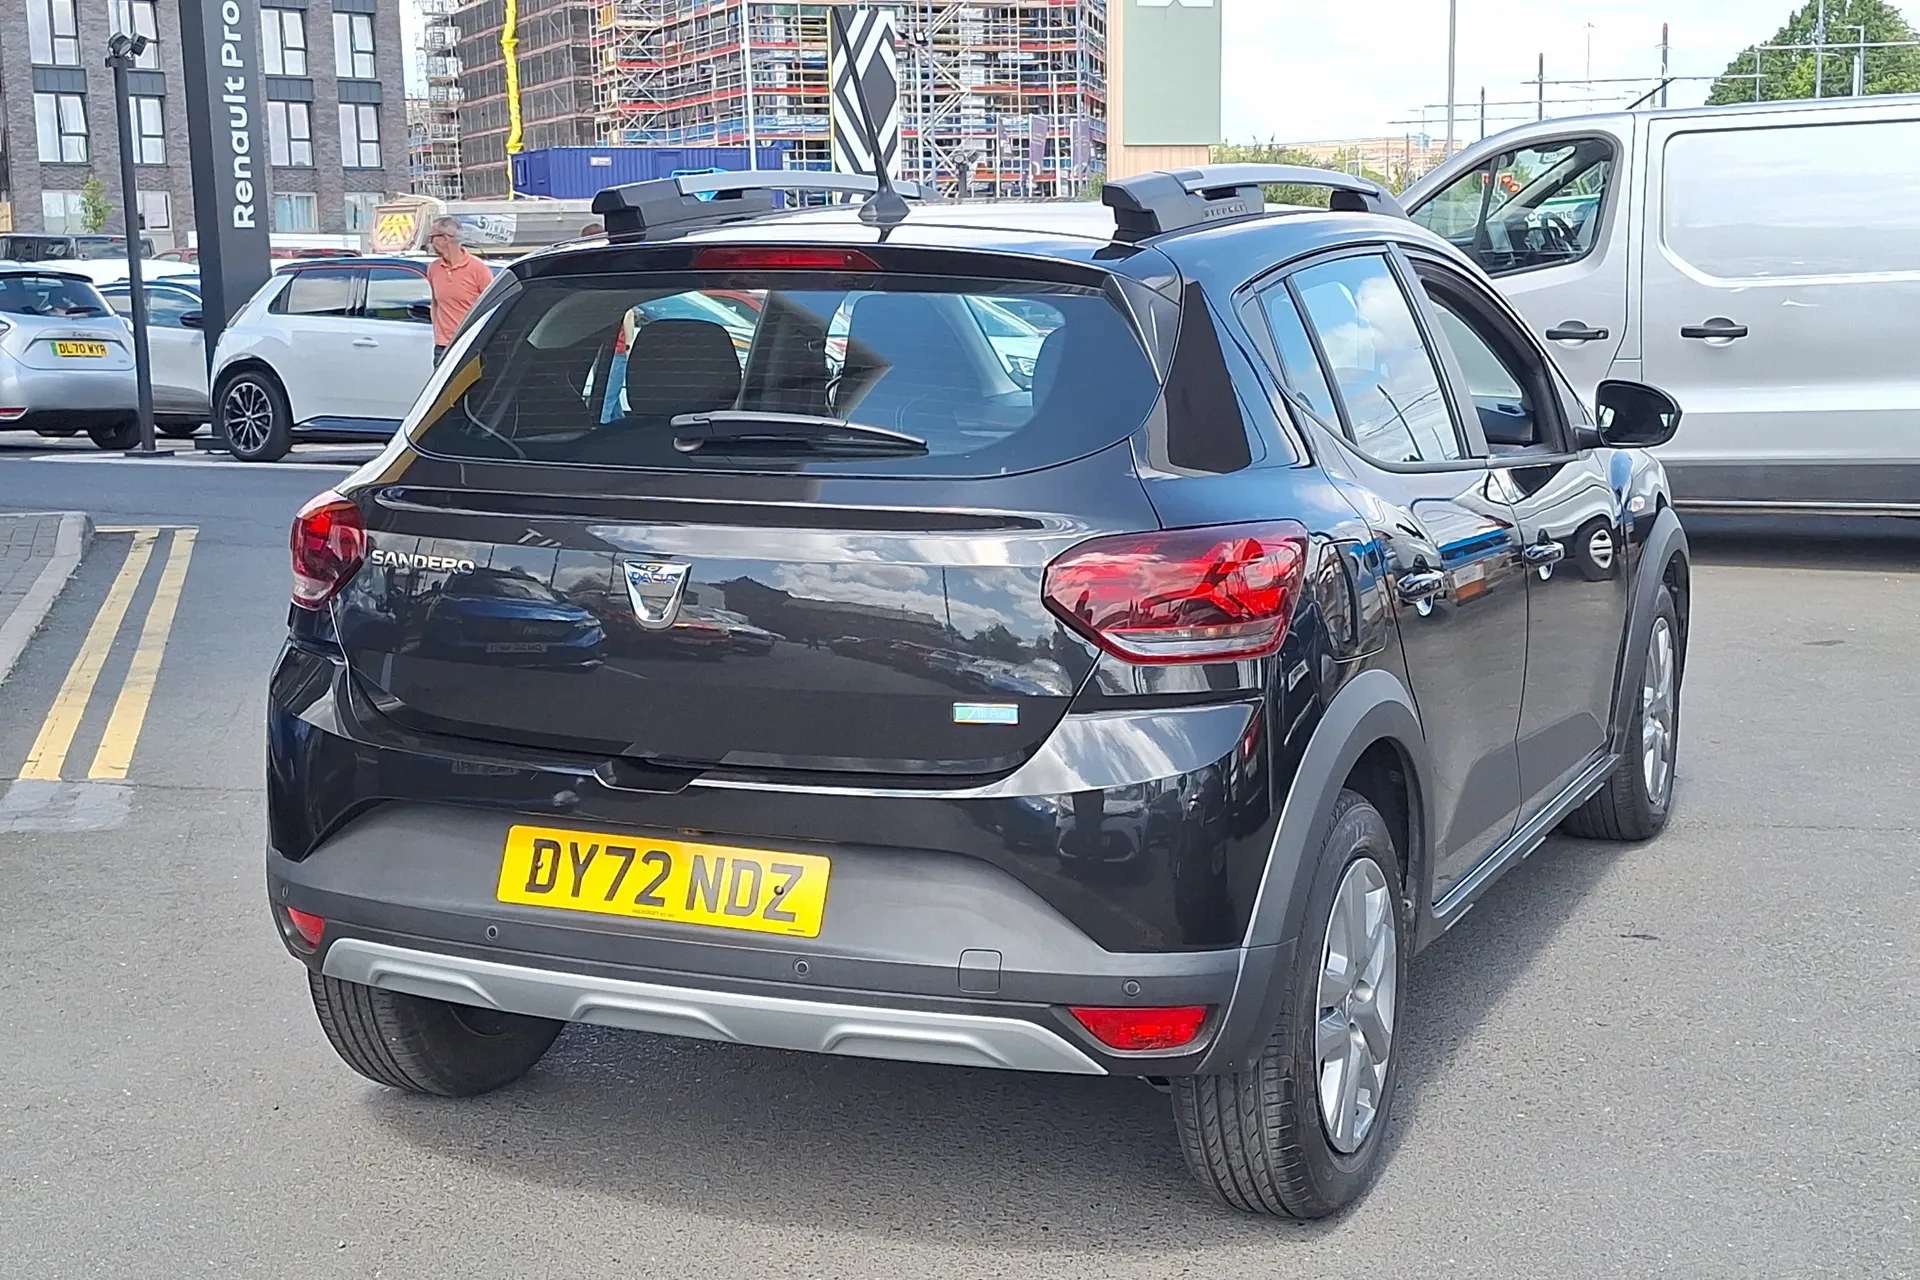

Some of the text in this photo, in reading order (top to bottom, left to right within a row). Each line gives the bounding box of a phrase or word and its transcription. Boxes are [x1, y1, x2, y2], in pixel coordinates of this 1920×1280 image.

[221, 0, 255, 228] Renault Pro
[371, 550, 475, 575] SANDERO
[630, 571, 678, 584] DACIA
[525, 838, 804, 922] DY72 NDZ
